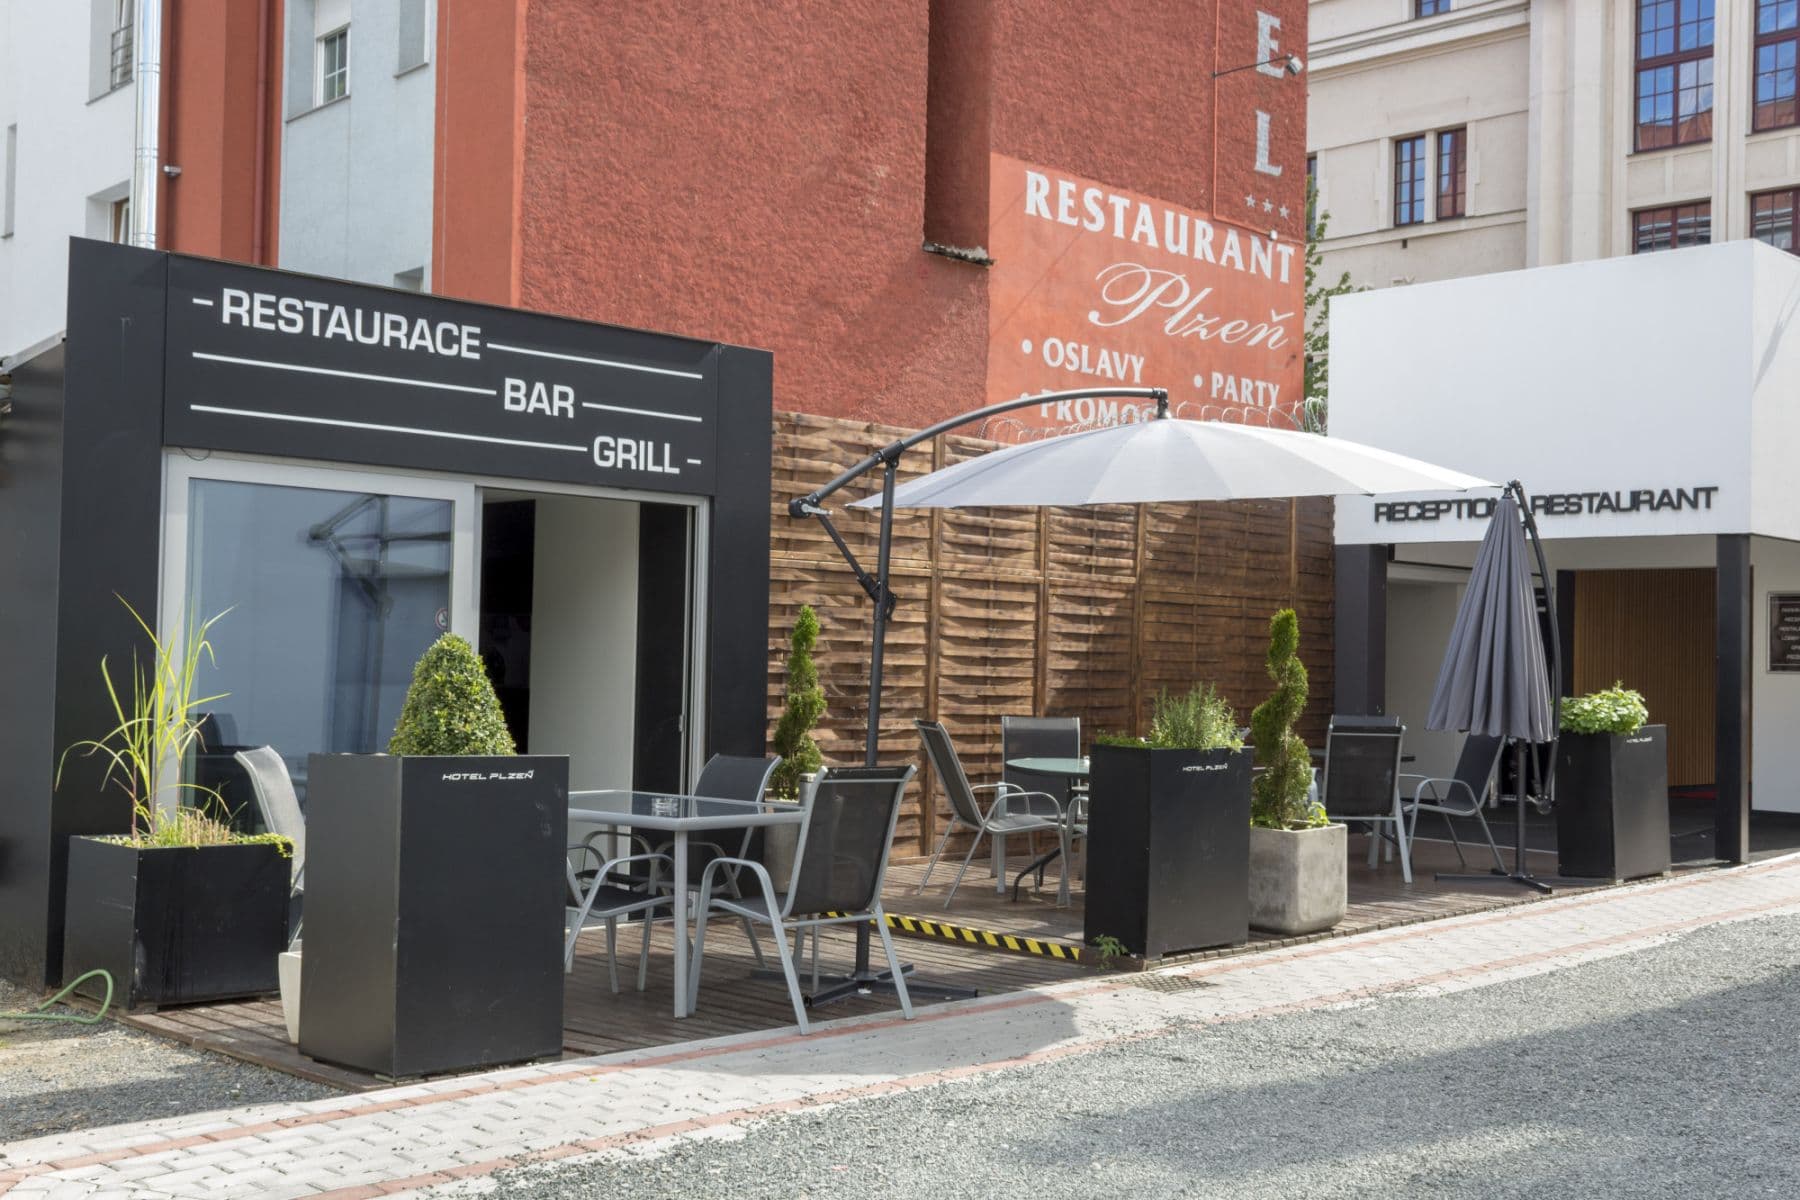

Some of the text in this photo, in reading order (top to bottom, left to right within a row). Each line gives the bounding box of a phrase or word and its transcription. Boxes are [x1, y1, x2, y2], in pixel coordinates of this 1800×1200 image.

[1024, 170, 1296, 284] RESTAURANT
[221, 288, 482, 360] RESTAURACE
[1088, 262, 1295, 350] Plzeň
[1042, 337, 1145, 384] OSLAVY
[503, 377, 576, 419] BAR
[1211, 371, 1281, 409] PARTY
[592, 435, 681, 474] GRILL
[1530, 486, 1719, 517] RESTAURANT
[442, 772, 487, 781] HOTEL
